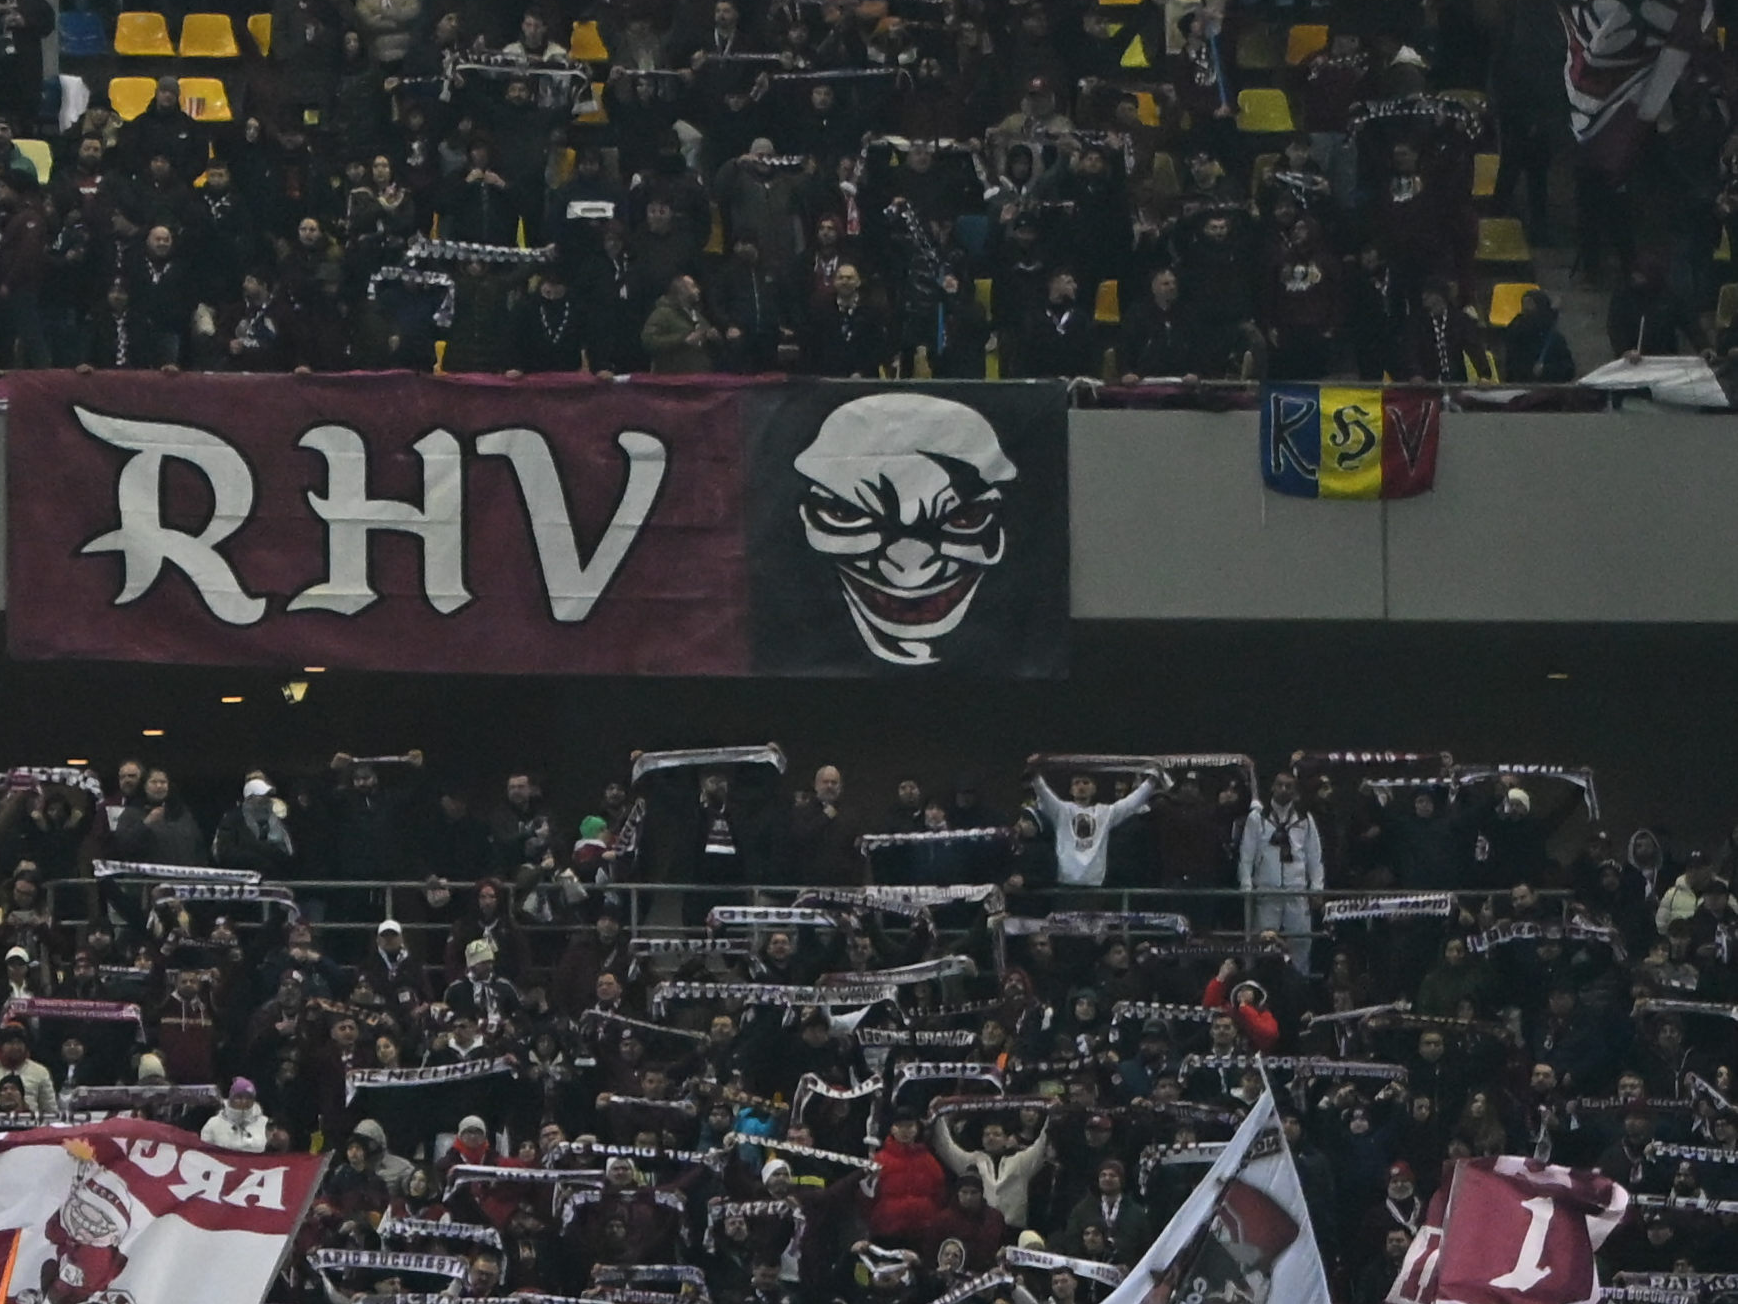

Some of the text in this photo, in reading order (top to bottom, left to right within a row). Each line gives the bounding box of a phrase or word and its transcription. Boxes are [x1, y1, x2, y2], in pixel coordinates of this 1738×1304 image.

[73, 403, 666, 625] RHV
[1326, 897, 1448, 918] FORZA RAPID
